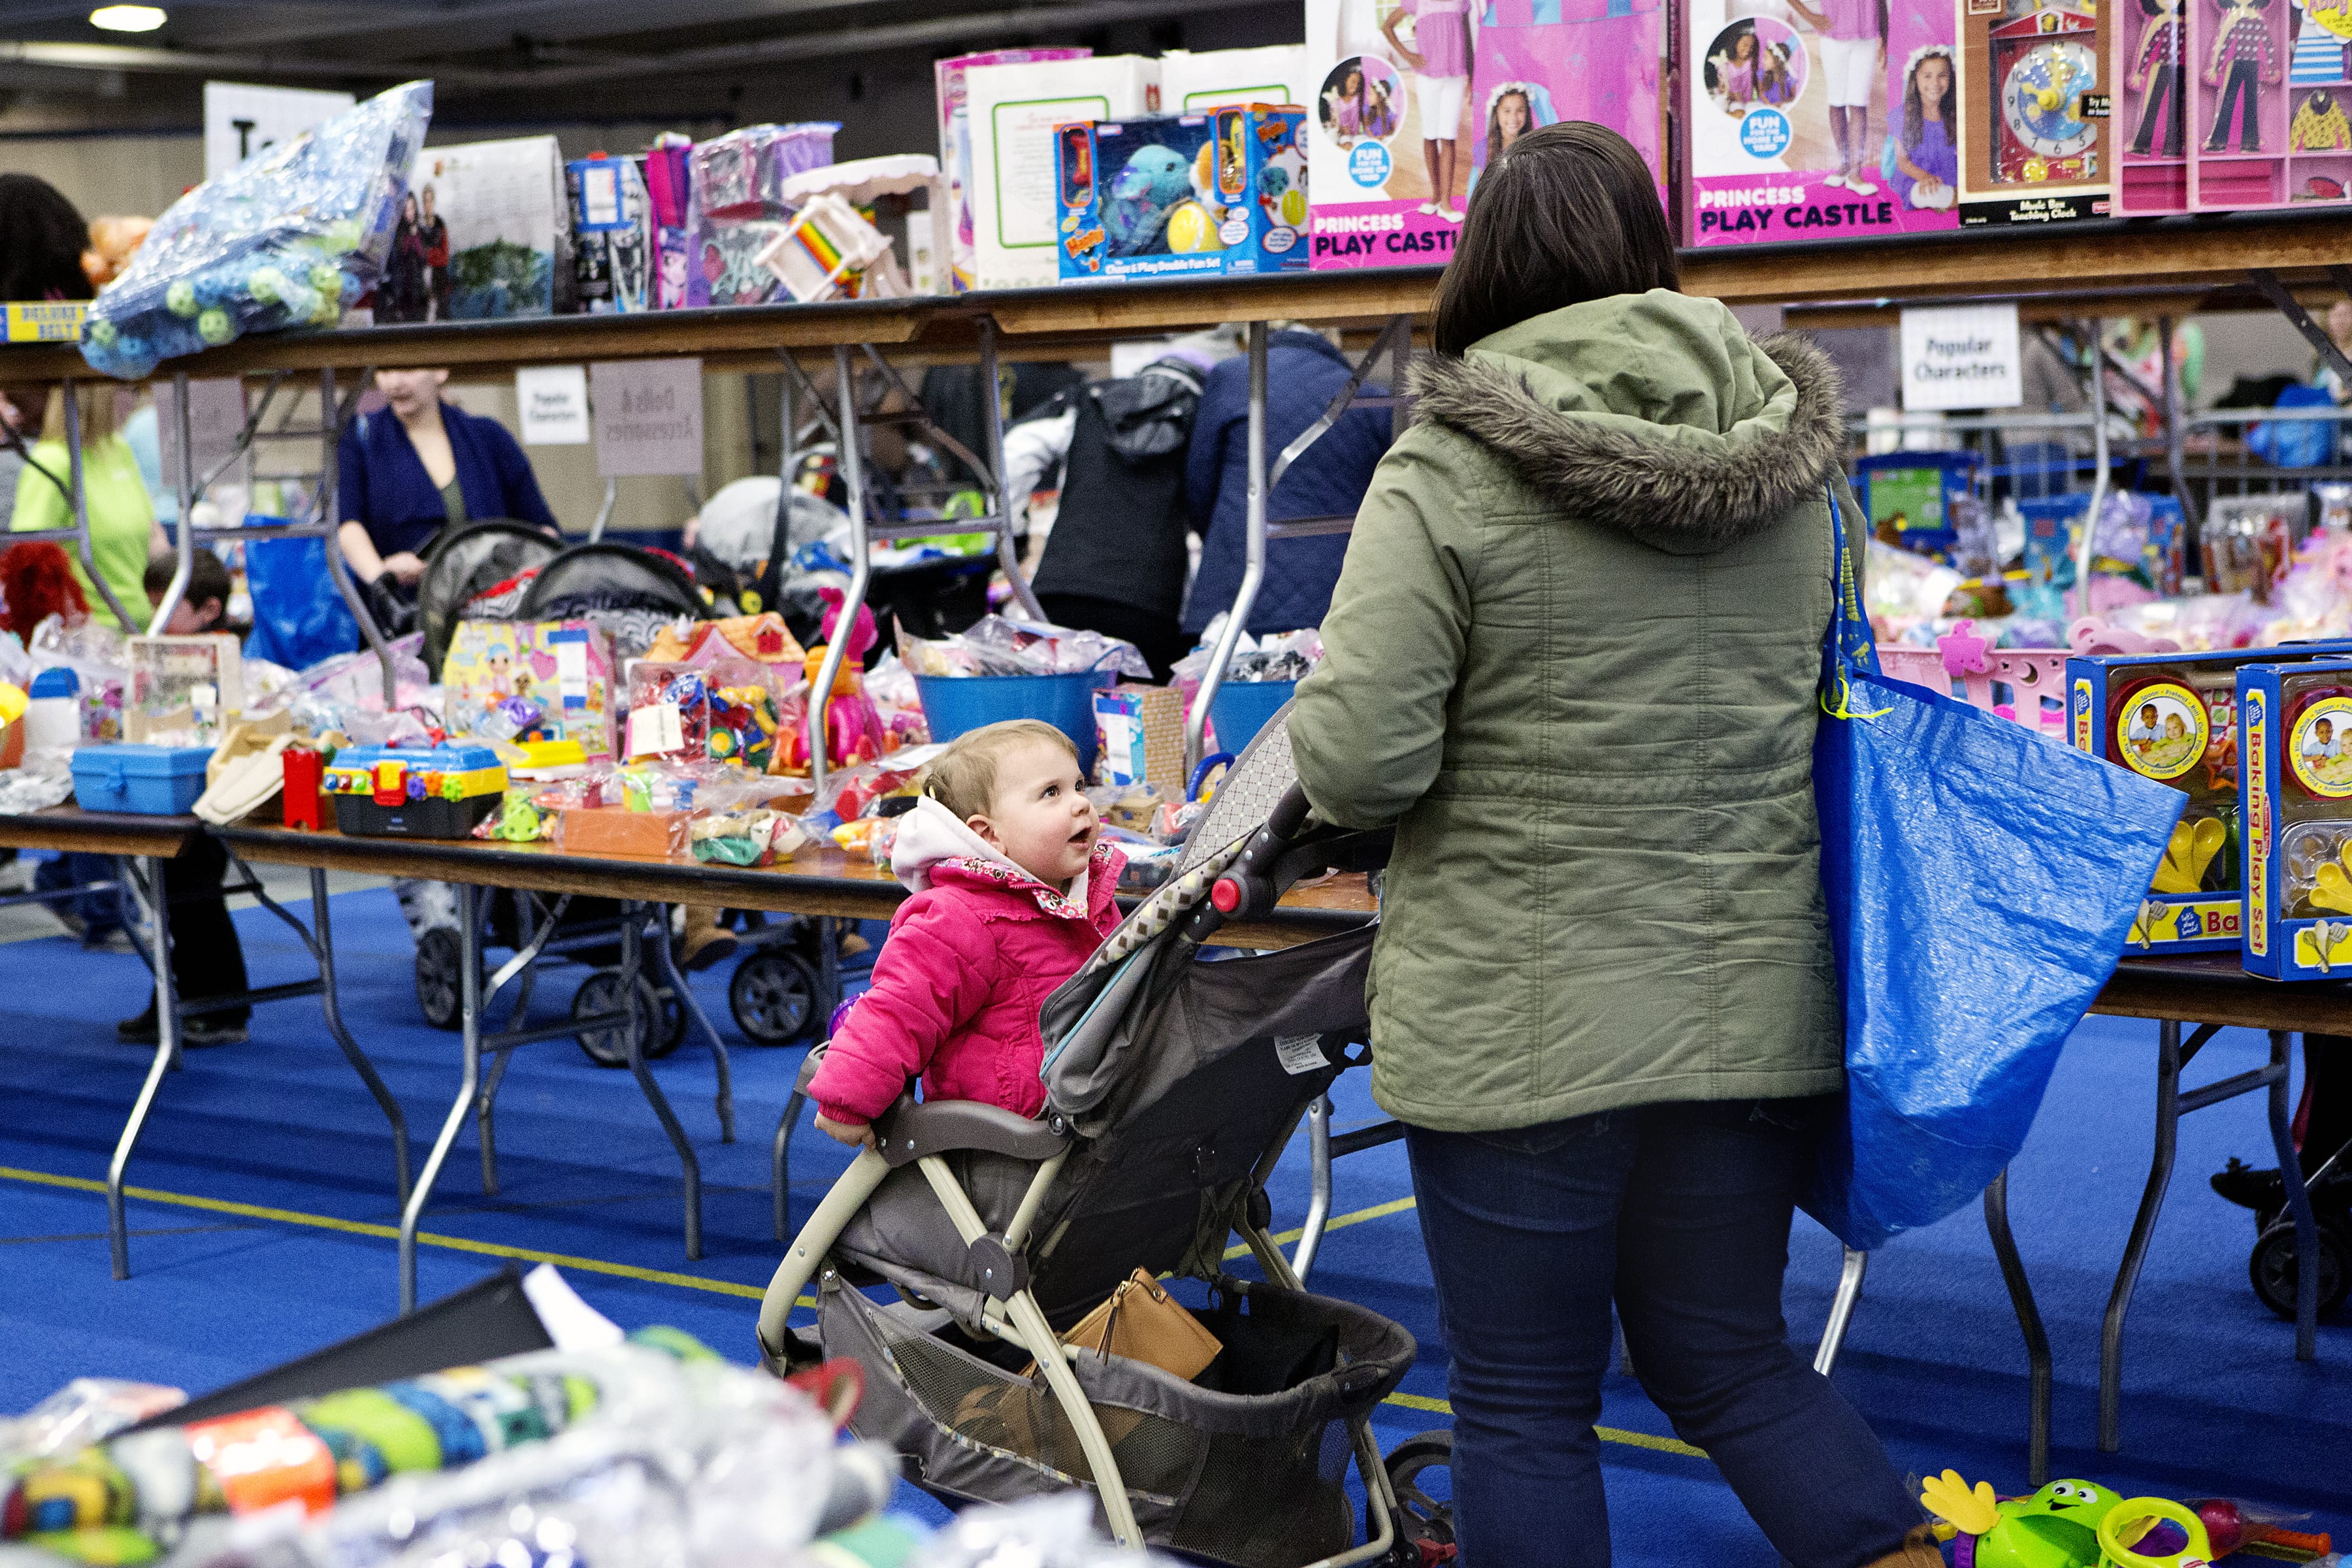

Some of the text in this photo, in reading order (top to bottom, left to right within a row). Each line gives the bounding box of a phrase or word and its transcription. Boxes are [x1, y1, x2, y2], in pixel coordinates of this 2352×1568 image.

[2012, 71, 2024, 83] 10
[2008, 96, 2015, 107] 9
[1749, 116, 1780, 129] FUN
[2014, 119, 2021, 131] 8
[2032, 138, 2038, 148] 7
[2080, 135, 2086, 147] 5
[2054, 143, 2061, 154] 6
[1356, 149, 1382, 161] FUN
[1700, 186, 1805, 208] PRINCESS
[2019, 199, 2066, 211] Music Box
[1701, 202, 1892, 232] PLAY CASTLE
[2010, 208, 2077, 222] Teaching Clock
[1315, 214, 1404, 234] PRINCESS
[1316, 234, 1376, 255] PLAY
[1137, 262, 1158, 274] Play
[1206, 258, 1221, 268] Set
[1927, 335, 1992, 357] Popular
[1914, 361, 2006, 381] Characters
[2141, 691, 2160, 701] Spoon
[2315, 704, 2334, 715] Spoon
[2133, 758, 2144, 770] Pour
[2249, 732, 2261, 828] Baking
[2306, 775, 2318, 787] Pour
[2251, 839, 2262, 900] Play
[2253, 907, 2263, 950] Set
